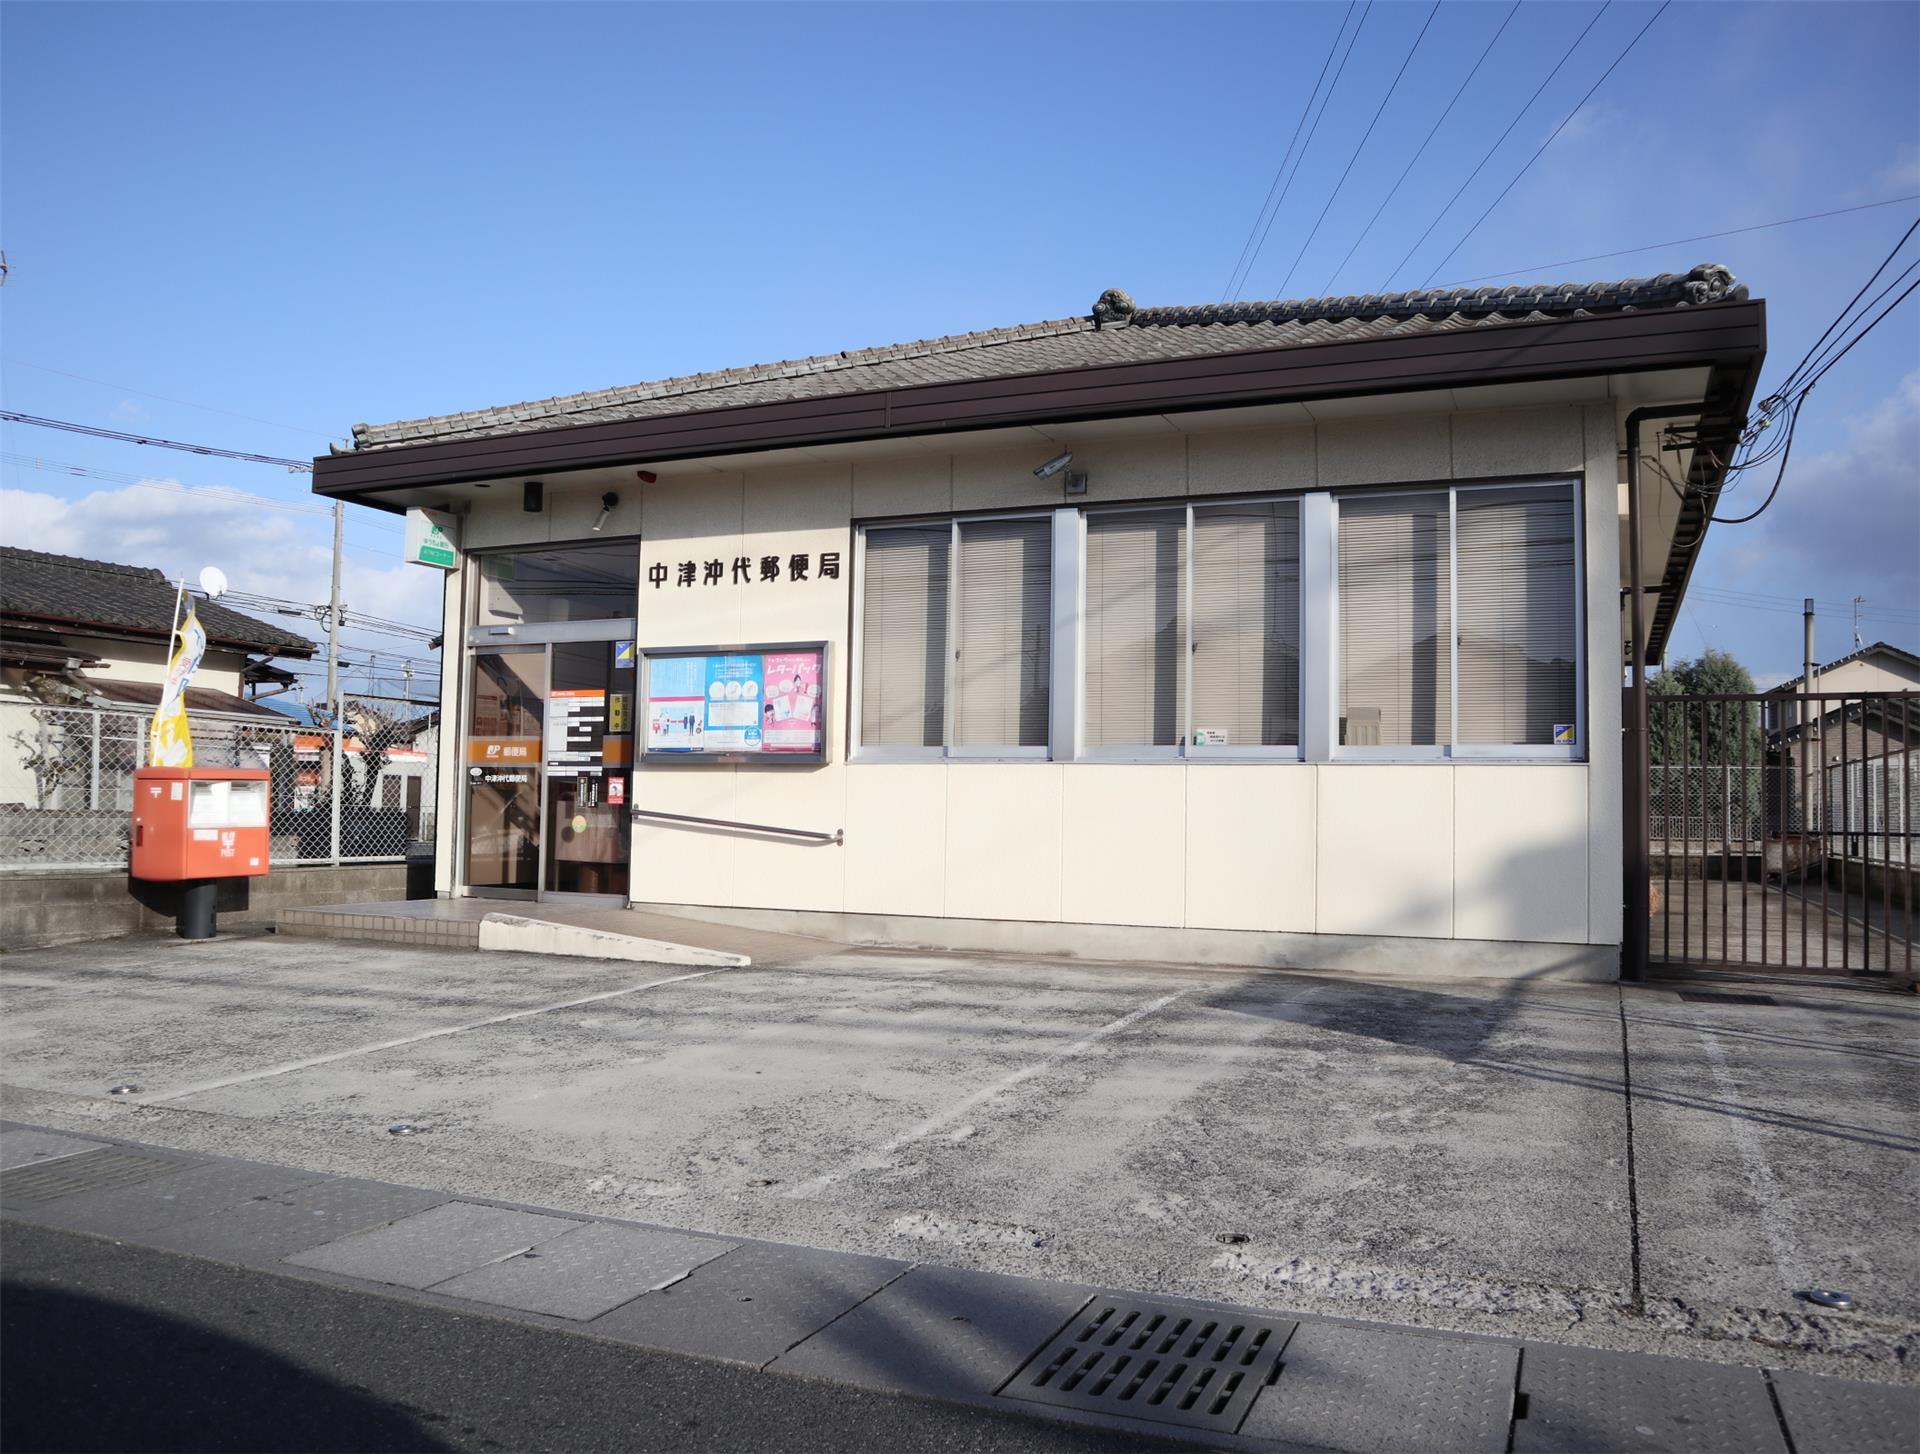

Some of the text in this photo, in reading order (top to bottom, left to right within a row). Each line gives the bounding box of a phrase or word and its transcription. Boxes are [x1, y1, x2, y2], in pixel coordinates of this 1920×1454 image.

[648, 552, 841, 589] 中津沖代郵便局
[767, 663, 821, 675] レターパック
[503, 746, 528, 757] 郵便局
[484, 774, 528, 783] 中津沖代郵便局
